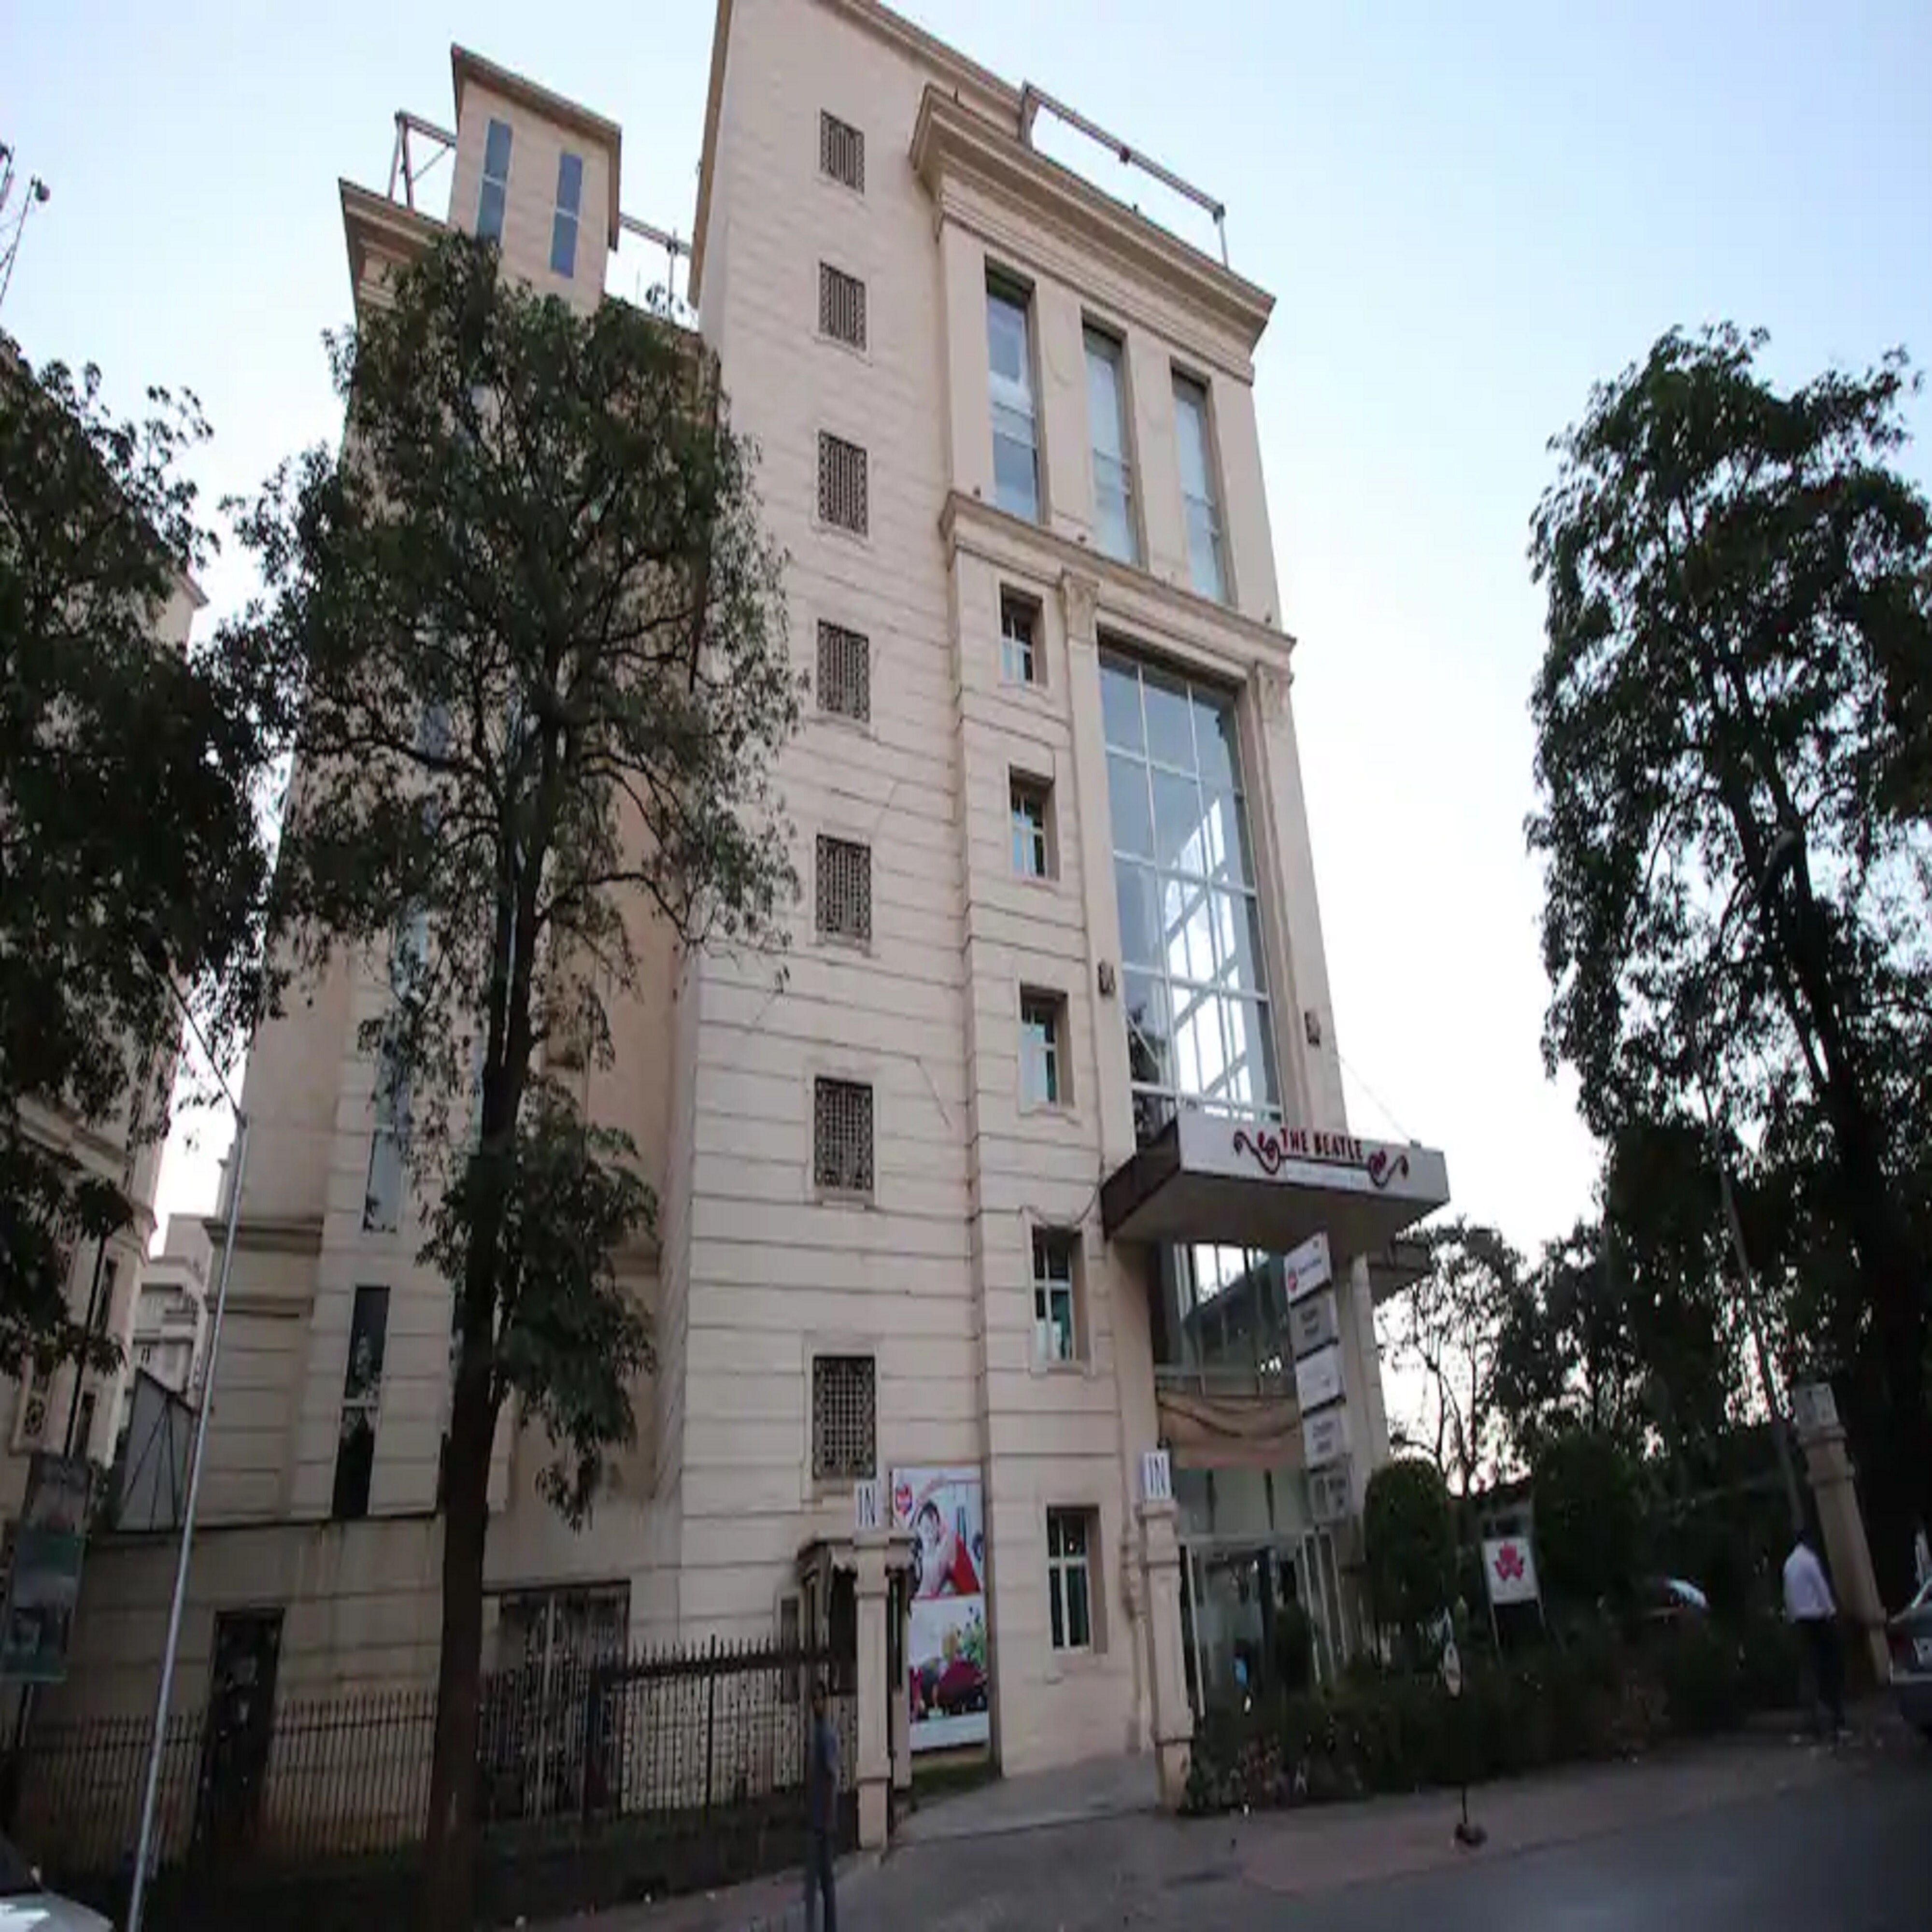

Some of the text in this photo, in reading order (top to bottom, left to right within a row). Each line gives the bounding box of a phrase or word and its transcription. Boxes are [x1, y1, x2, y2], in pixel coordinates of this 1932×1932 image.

[1280, 1128, 1363, 1160] THE BEATLE
[1149, 1455, 1166, 1496] IN
[858, 1483, 875, 1527] IN
